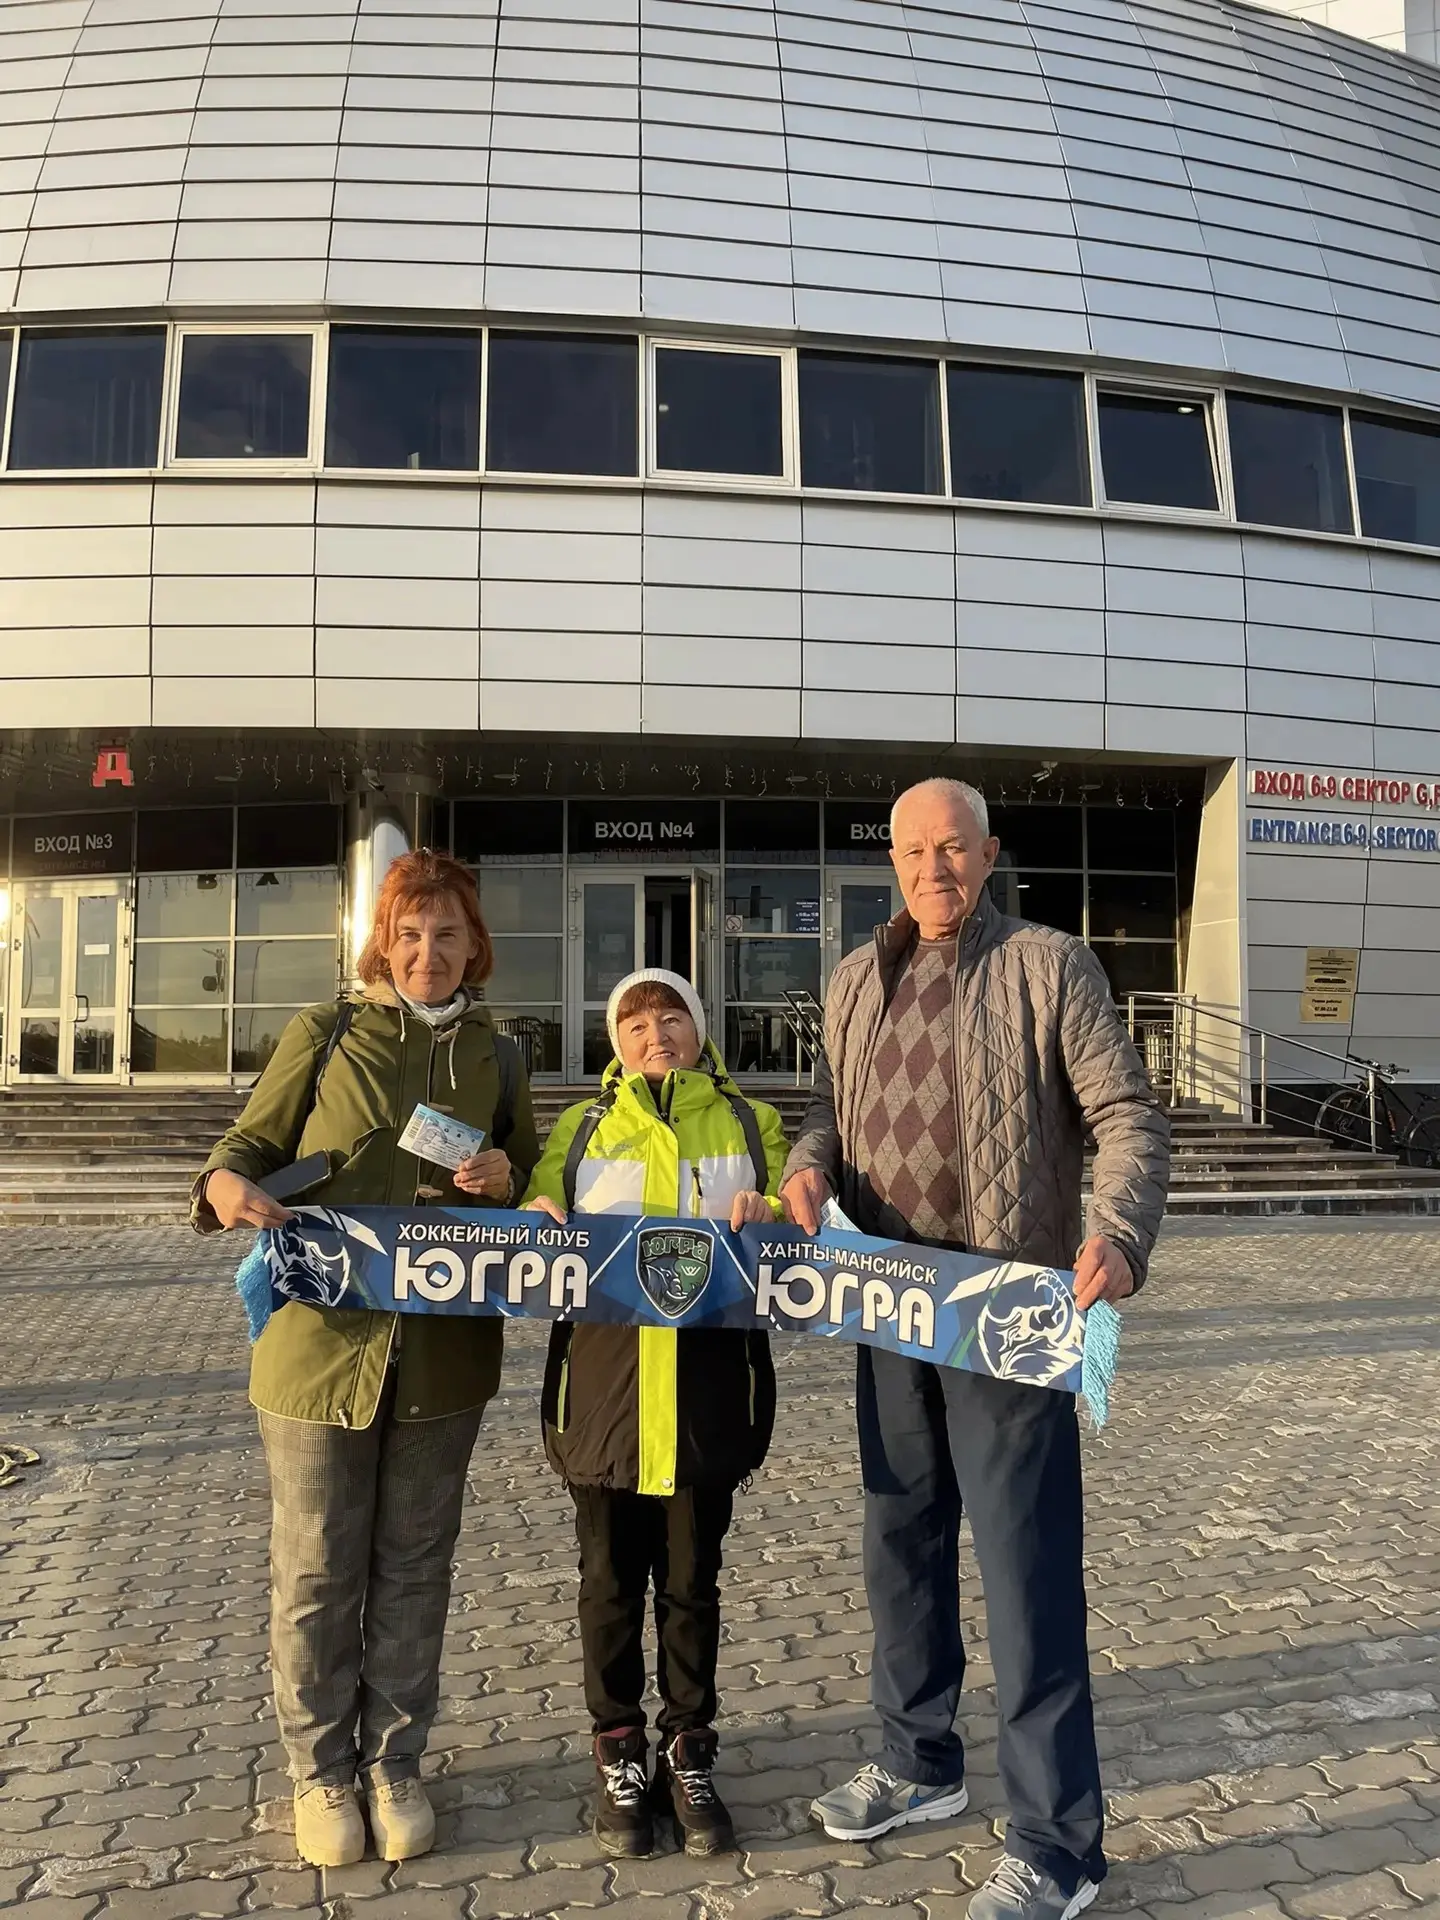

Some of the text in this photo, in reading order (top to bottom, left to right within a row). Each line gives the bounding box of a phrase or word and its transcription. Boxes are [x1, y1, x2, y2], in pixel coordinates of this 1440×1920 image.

[1251, 770, 1305, 800] ВХОД
[1308, 774, 1336, 798] 6-9
[1340, 777, 1411, 804] СЕКТОР
[34, 833, 113, 853] ВХОД №3
[595, 821, 694, 841] ВХОД №4
[850, 823, 892, 840] ВХО
[1250, 818, 1341, 845] ENTRANCE
[1373, 825, 1436, 851] SECTOR
[398, 1223, 590, 1248] ХОККЕЙНЫЙ КЛУБ
[393, 1246, 589, 1308] ЮГРА
[759, 1241, 938, 1285] ХАНТЫ-МАНСИЙСК
[755, 1264, 936, 1348] ЮГРА
